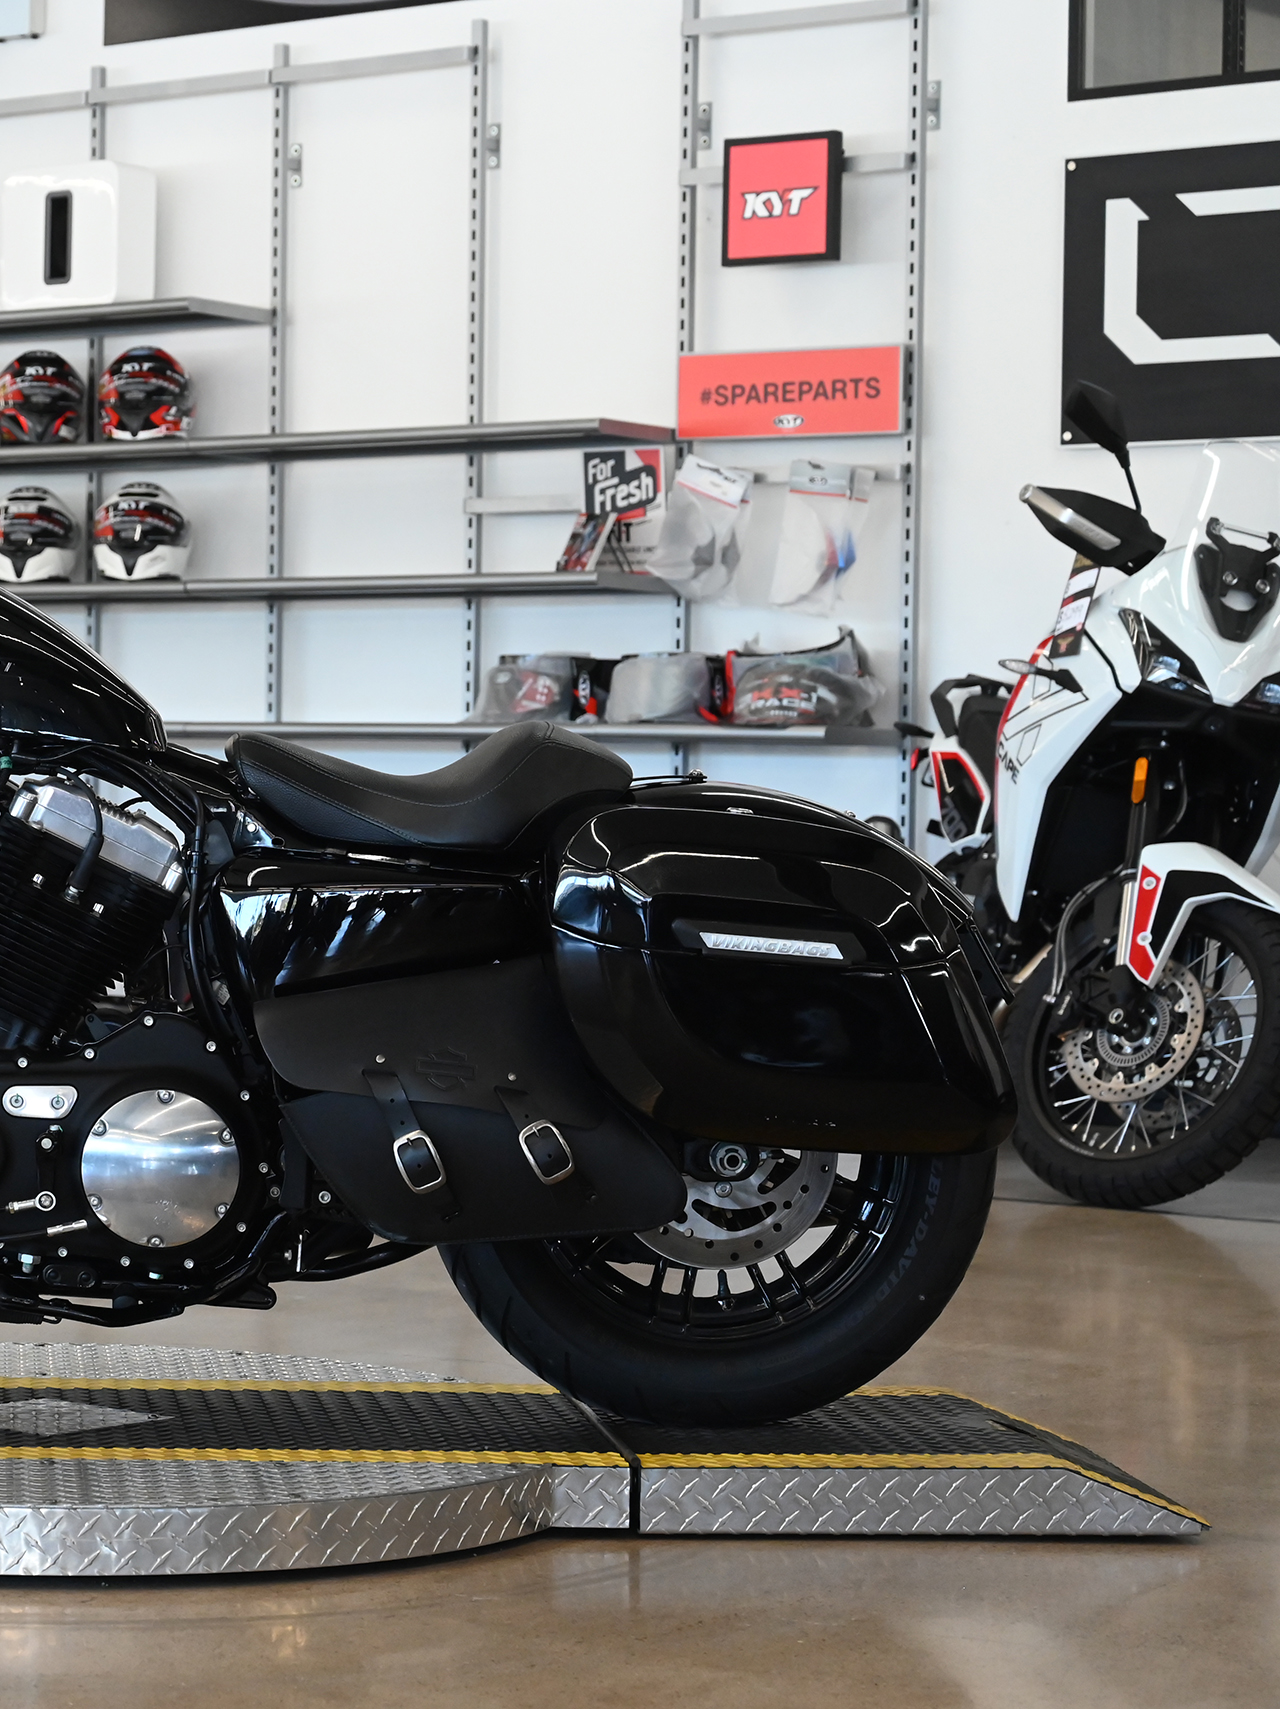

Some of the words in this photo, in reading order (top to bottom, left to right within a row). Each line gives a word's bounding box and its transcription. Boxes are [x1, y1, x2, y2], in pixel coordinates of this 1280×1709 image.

[741, 186, 818, 219] KYT
[700, 377, 881, 407] #SPAREPARTS
[587, 457, 616, 485] For
[594, 472, 654, 515] Fresh
[710, 934, 832, 957] VIKINGBAGS
